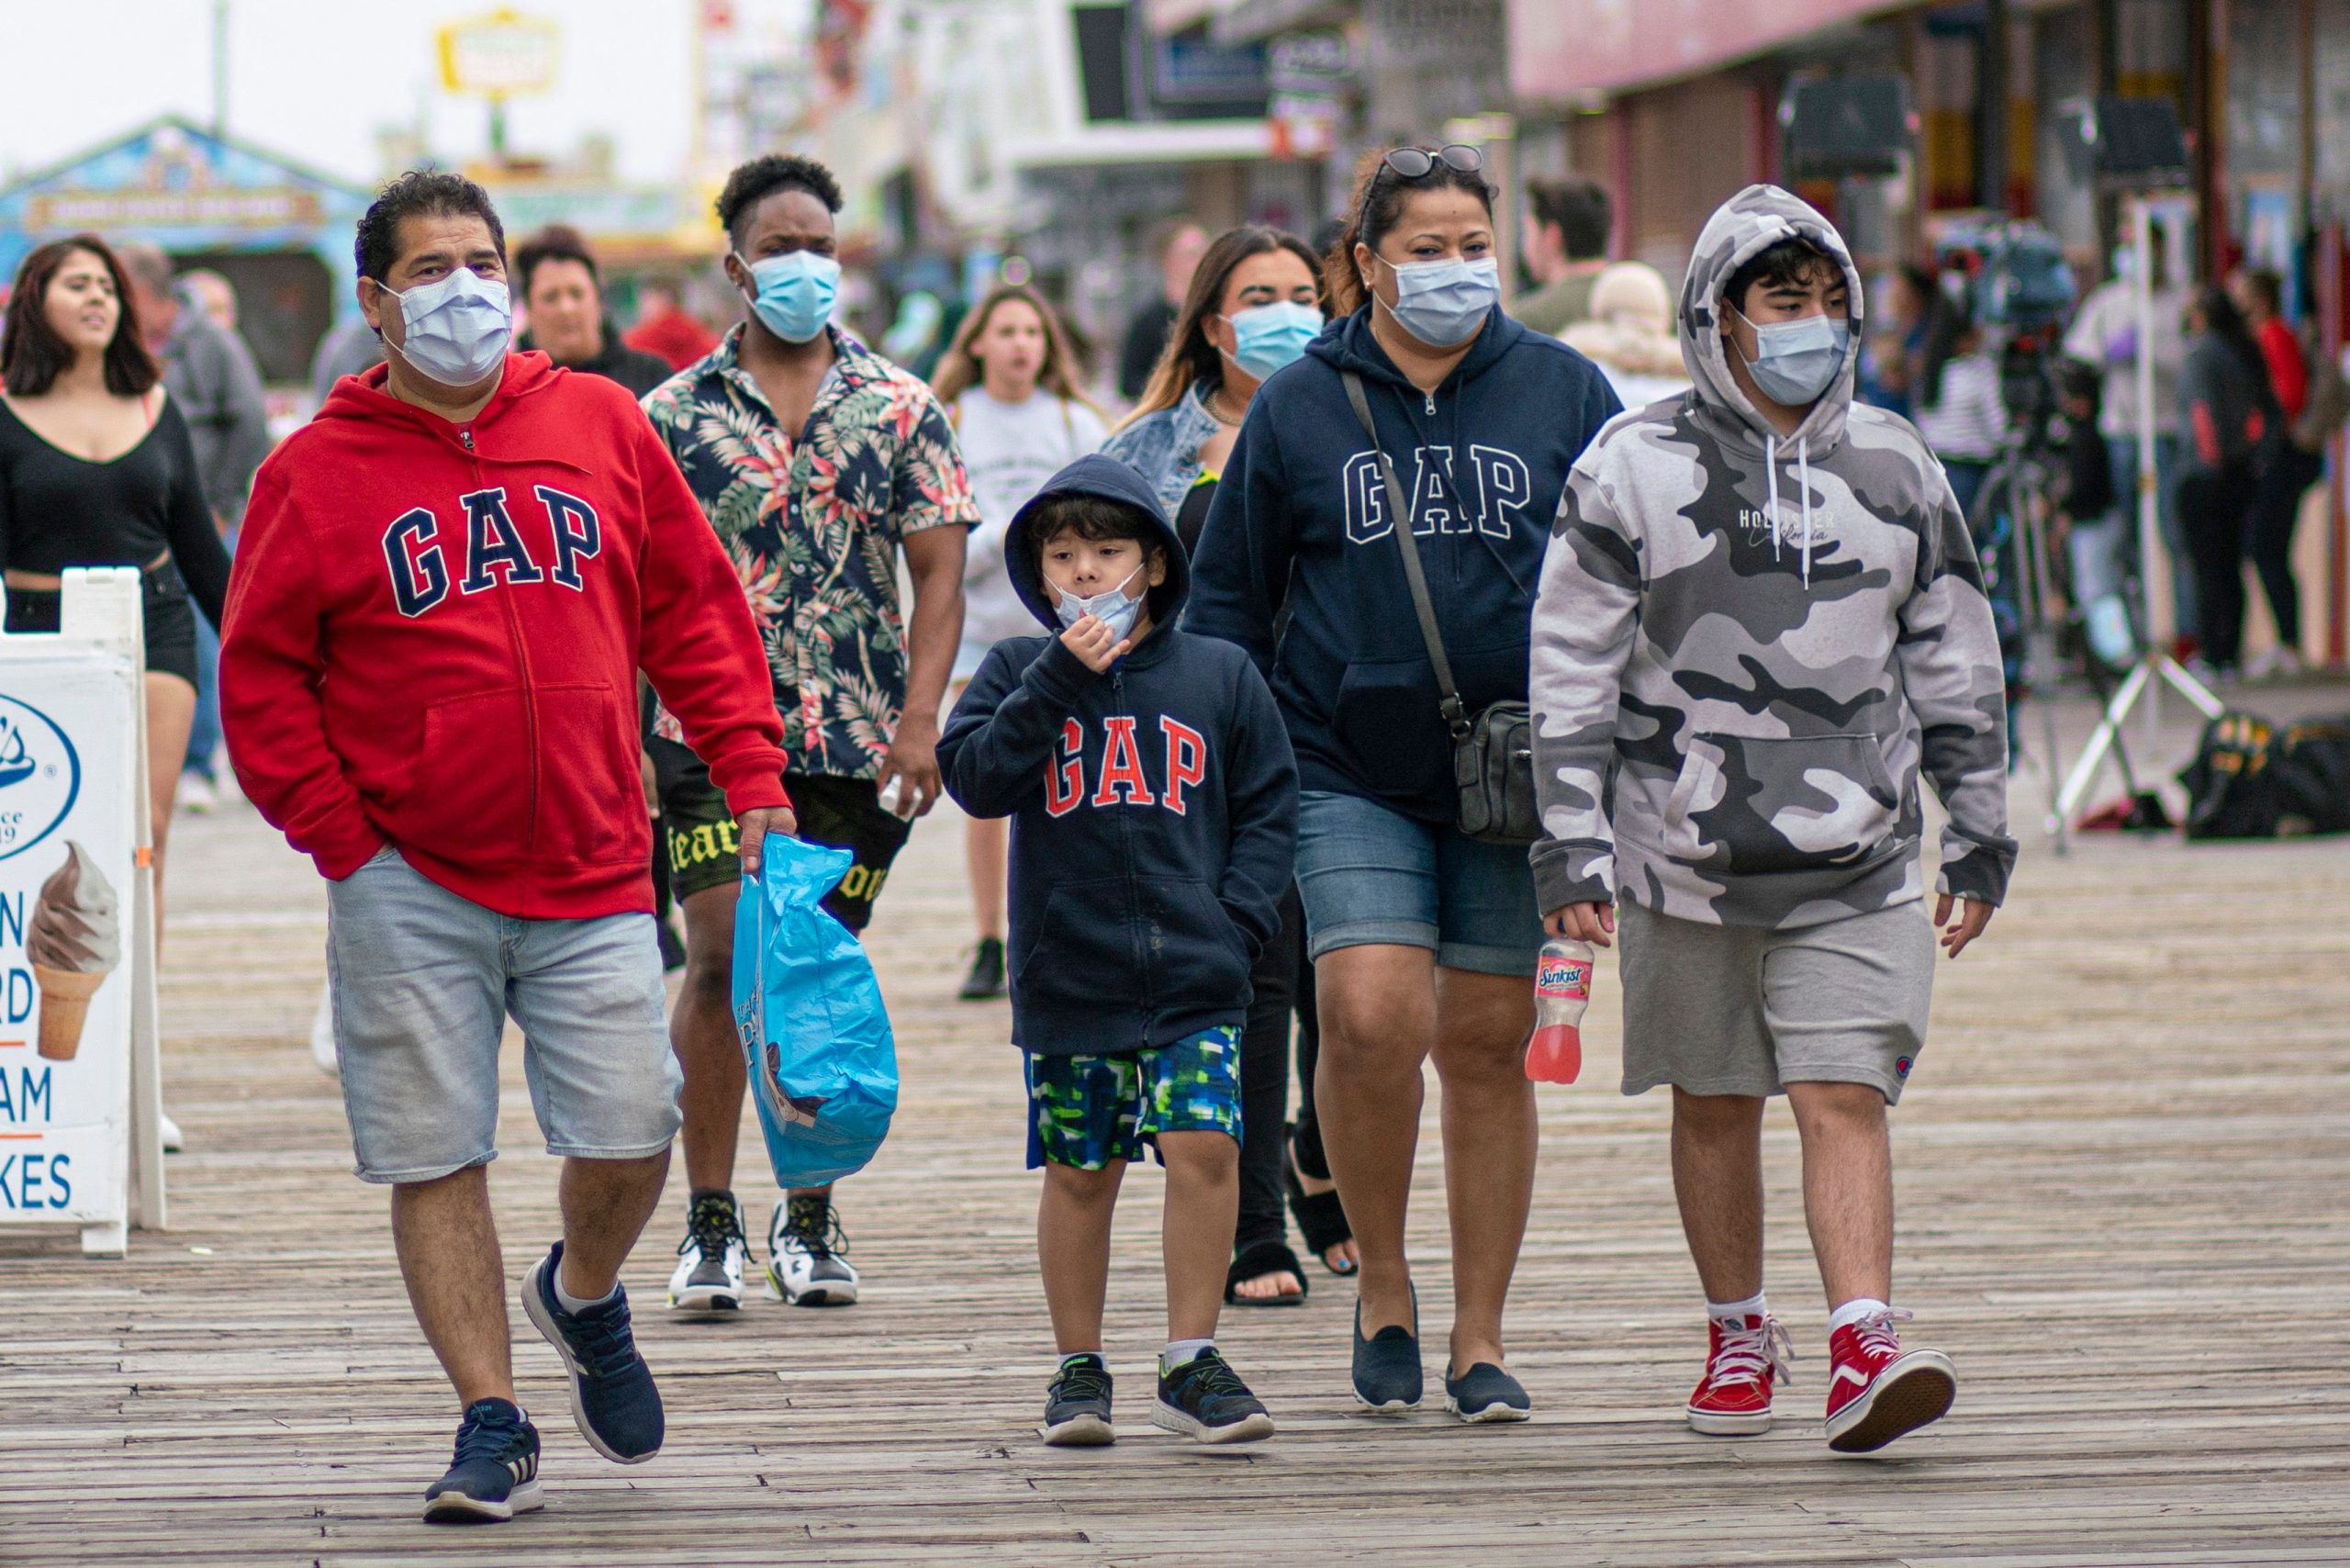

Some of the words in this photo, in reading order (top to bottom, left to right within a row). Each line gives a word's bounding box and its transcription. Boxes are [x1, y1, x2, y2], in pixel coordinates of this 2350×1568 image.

[1343, 443, 1531, 544] GAP
[1739, 510, 1836, 530] HOLISER
[382, 485, 601, 619] GAP
[1044, 713, 1207, 818] GAP
[0, 968, 33, 1024] D
[1539, 968, 1583, 987] Sunkist
